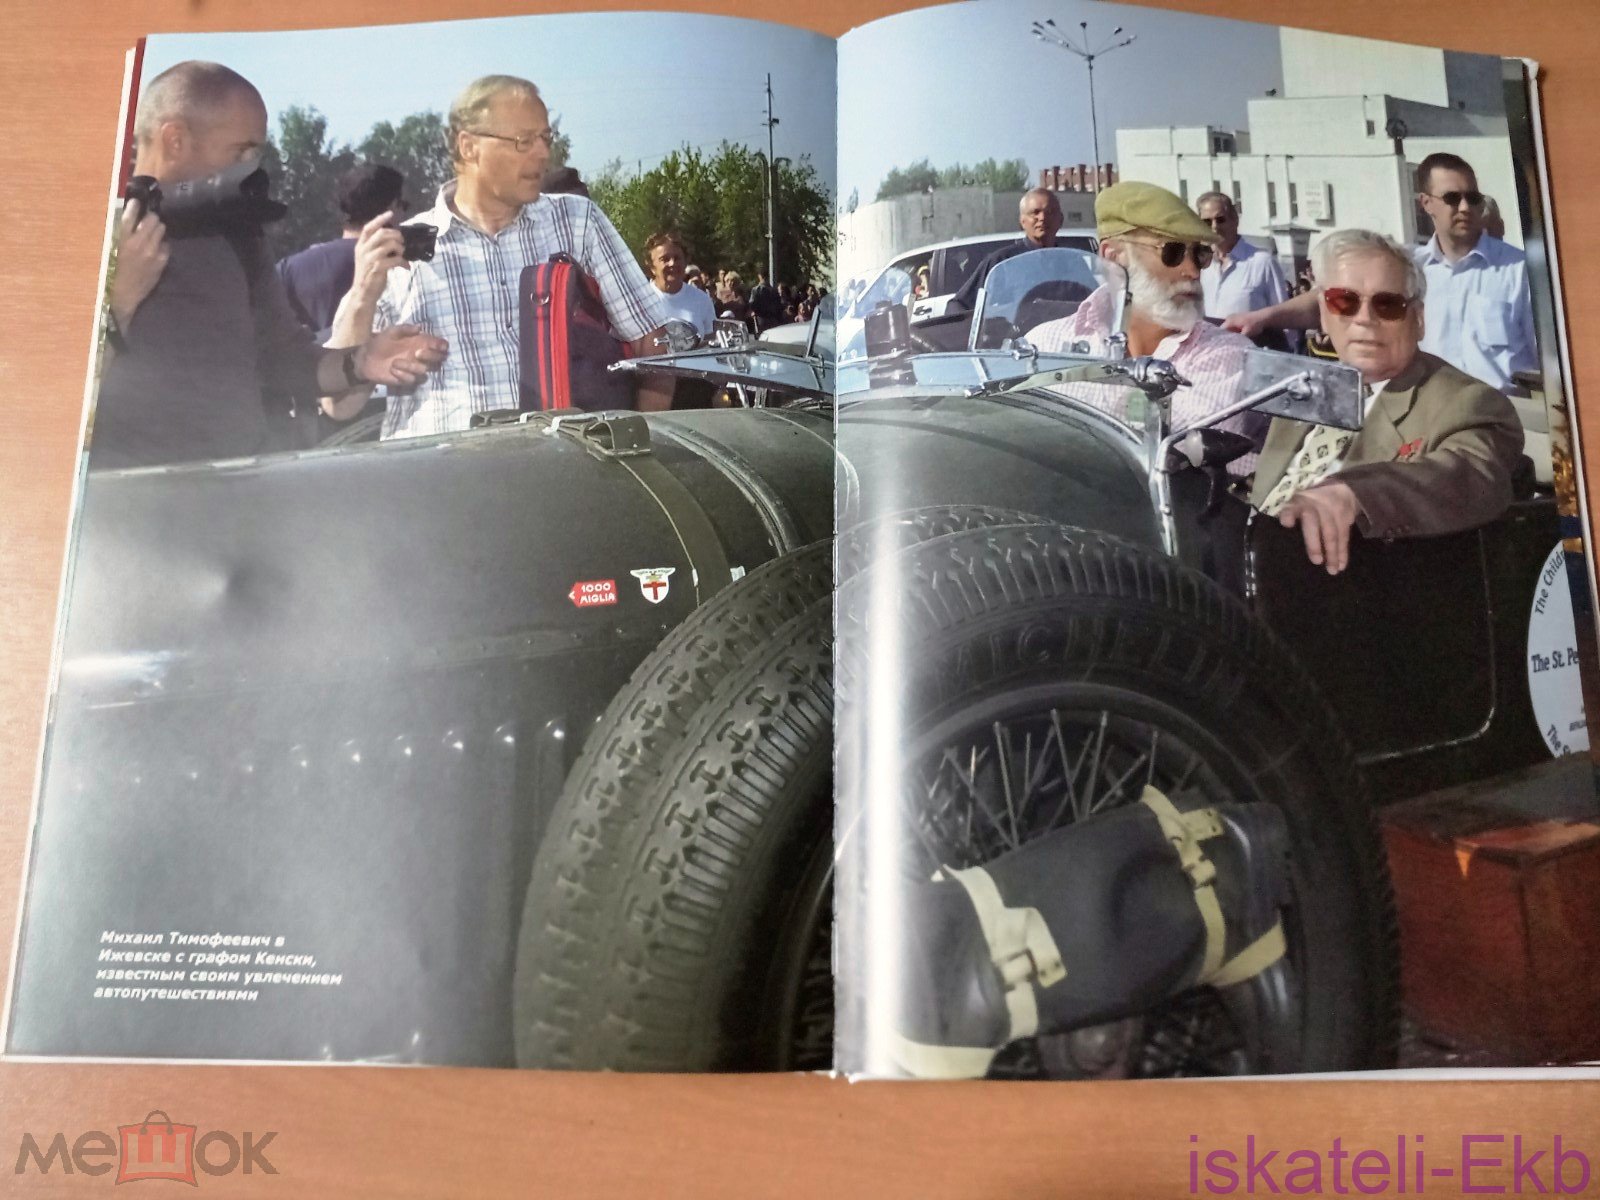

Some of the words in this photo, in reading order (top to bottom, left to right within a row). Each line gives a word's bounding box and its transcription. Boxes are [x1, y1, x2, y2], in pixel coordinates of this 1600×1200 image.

[581, 583, 611, 593] 1000
[580, 593, 616, 604] MIGLIA
[1531, 653, 1550, 672] The
[100, 930, 164, 945] Михаил
[170, 931, 271, 948] Тимофеевич
[275, 936, 285, 947] в
[98, 949, 171, 963] Ижевске
[175, 954, 185, 963] с
[188, 952, 251, 966] графом
[255, 951, 317, 968] Кенски,
[95, 968, 185, 981] известным
[189, 971, 240, 982] своим
[243, 972, 342, 985] увлечением
[93, 986, 259, 1002] автопутешествиями
